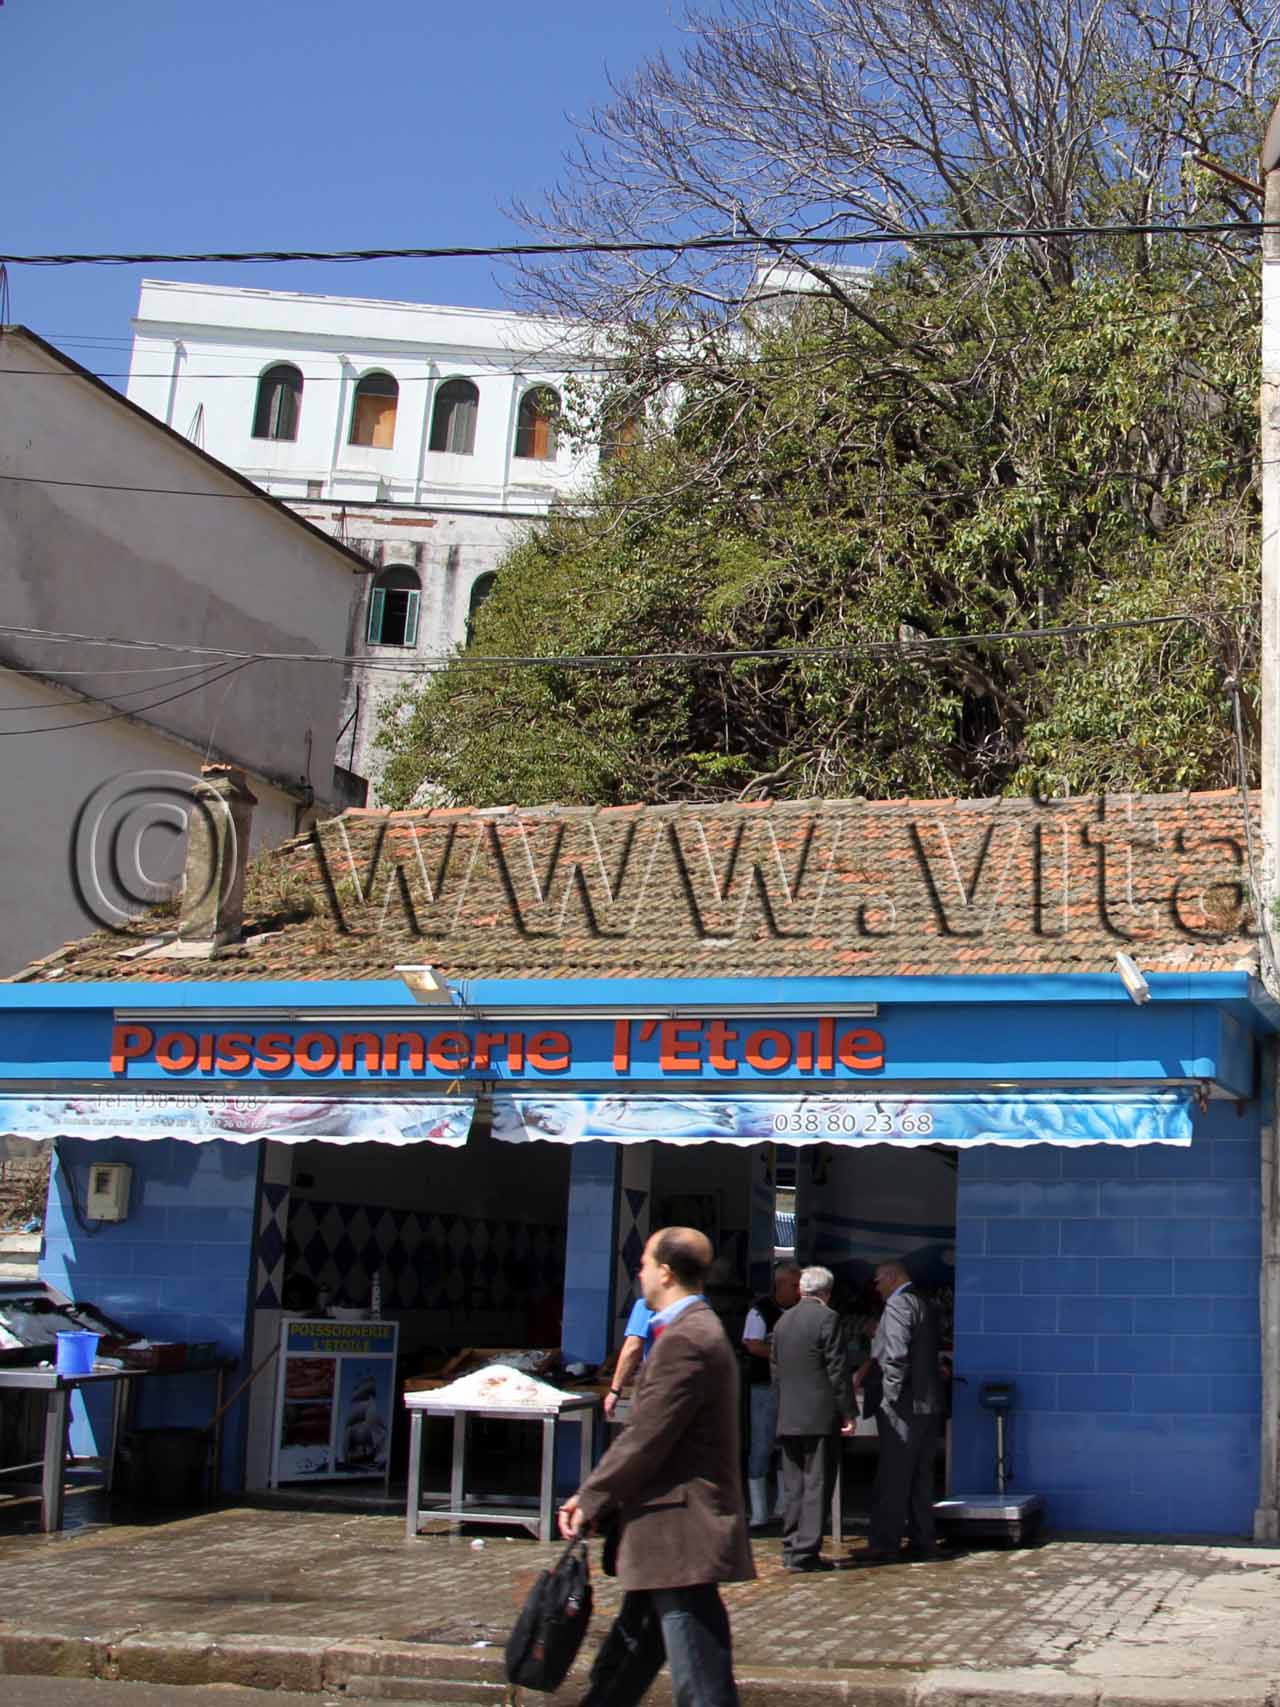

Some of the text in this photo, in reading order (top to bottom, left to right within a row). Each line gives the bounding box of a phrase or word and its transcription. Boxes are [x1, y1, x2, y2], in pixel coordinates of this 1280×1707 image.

[110, 1016, 886, 1073] Poissonnerie l'Etoile
[774, 1113, 933, 1135] 038 80 23 68
